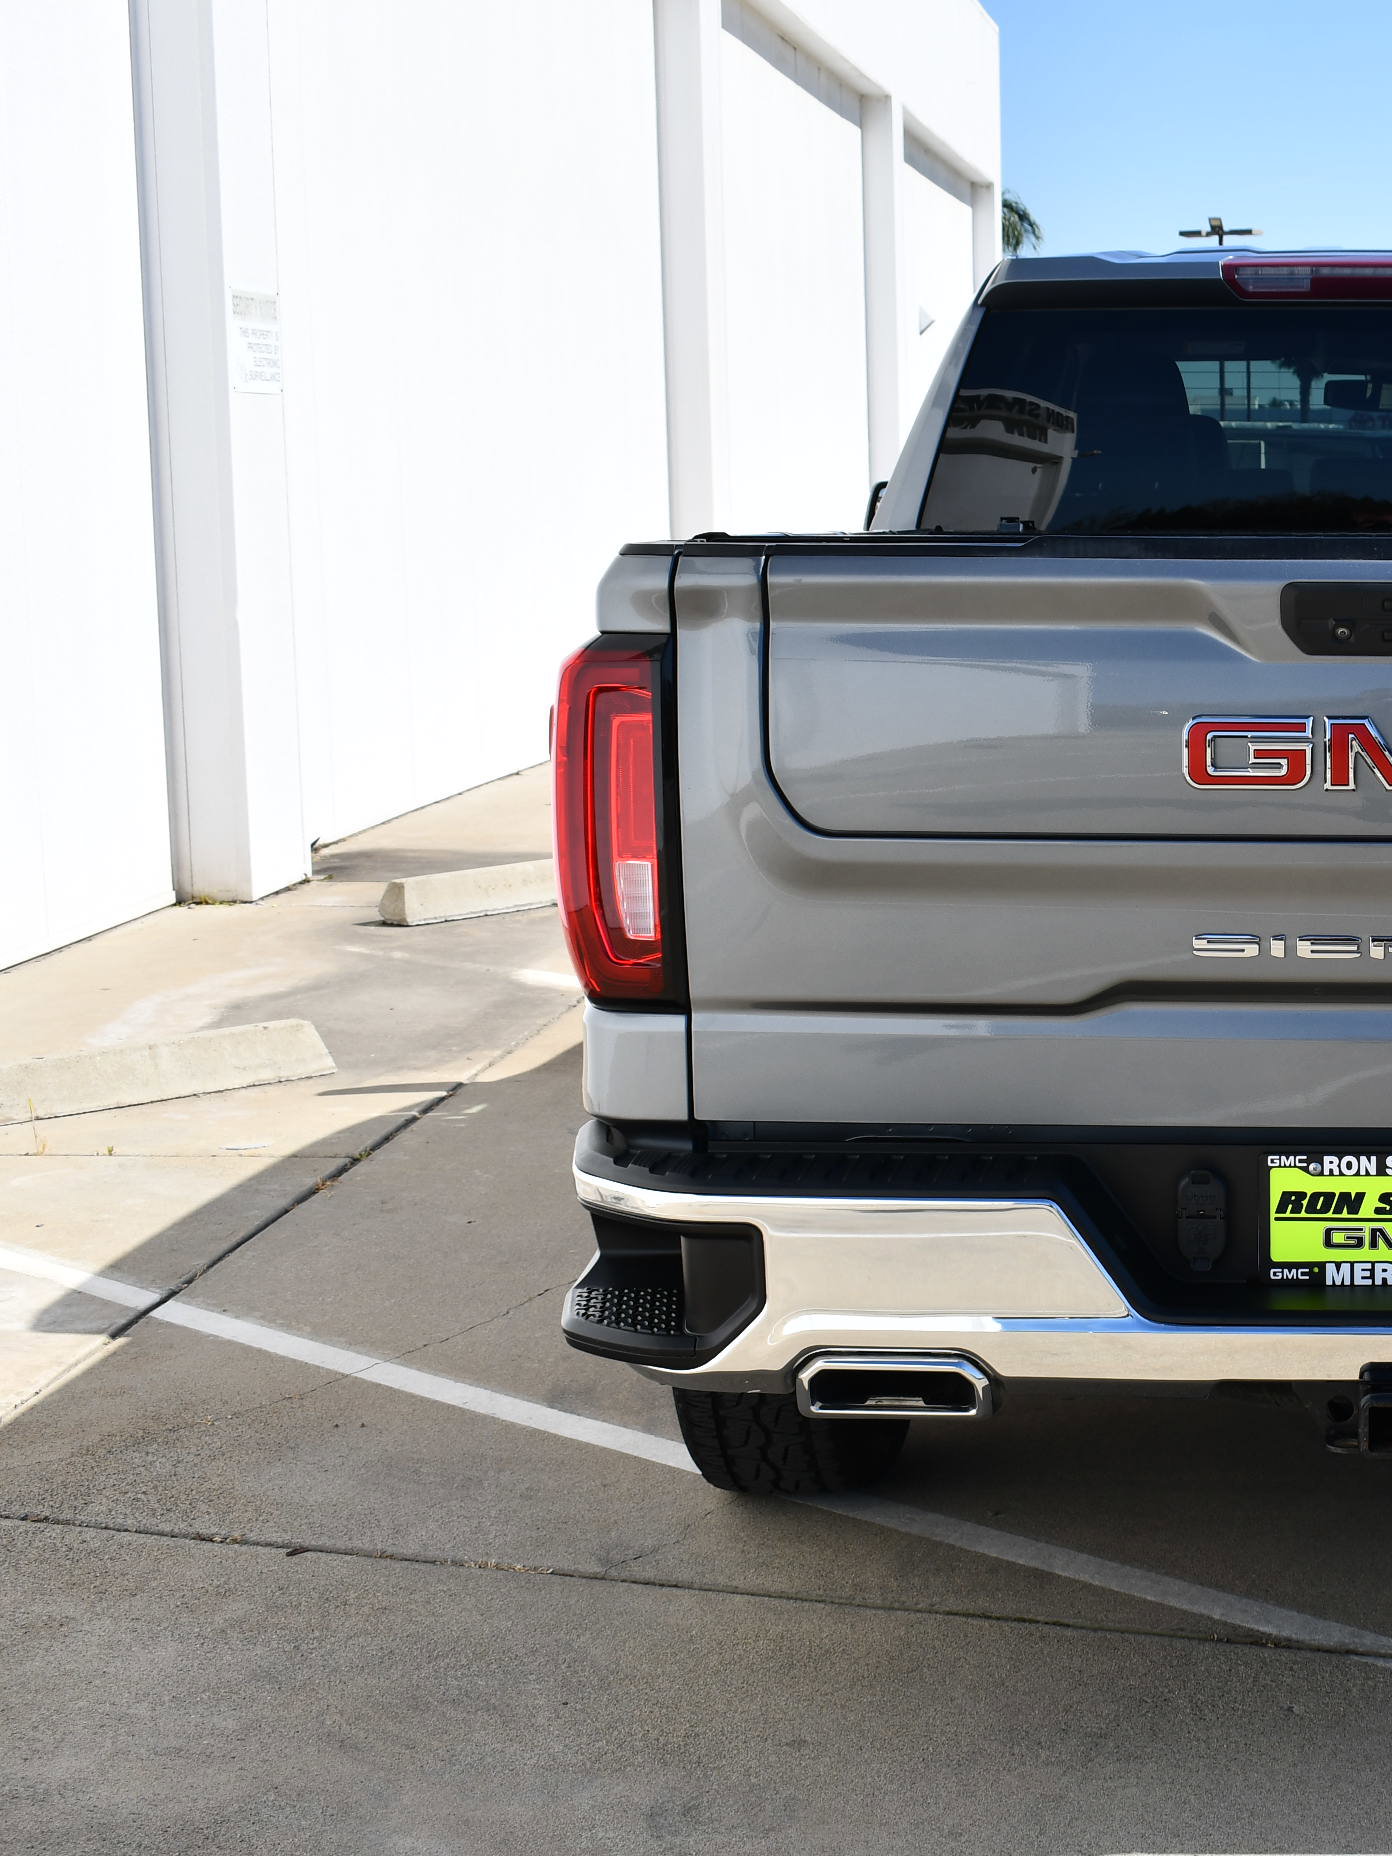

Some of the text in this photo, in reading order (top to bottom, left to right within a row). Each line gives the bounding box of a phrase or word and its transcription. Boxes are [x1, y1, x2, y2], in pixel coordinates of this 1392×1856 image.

[1267, 1155, 1307, 1167] GMC
[1323, 1155, 1377, 1176] RON
[1274, 1190, 1367, 1215] RON
[1269, 1268, 1310, 1280] GMC
